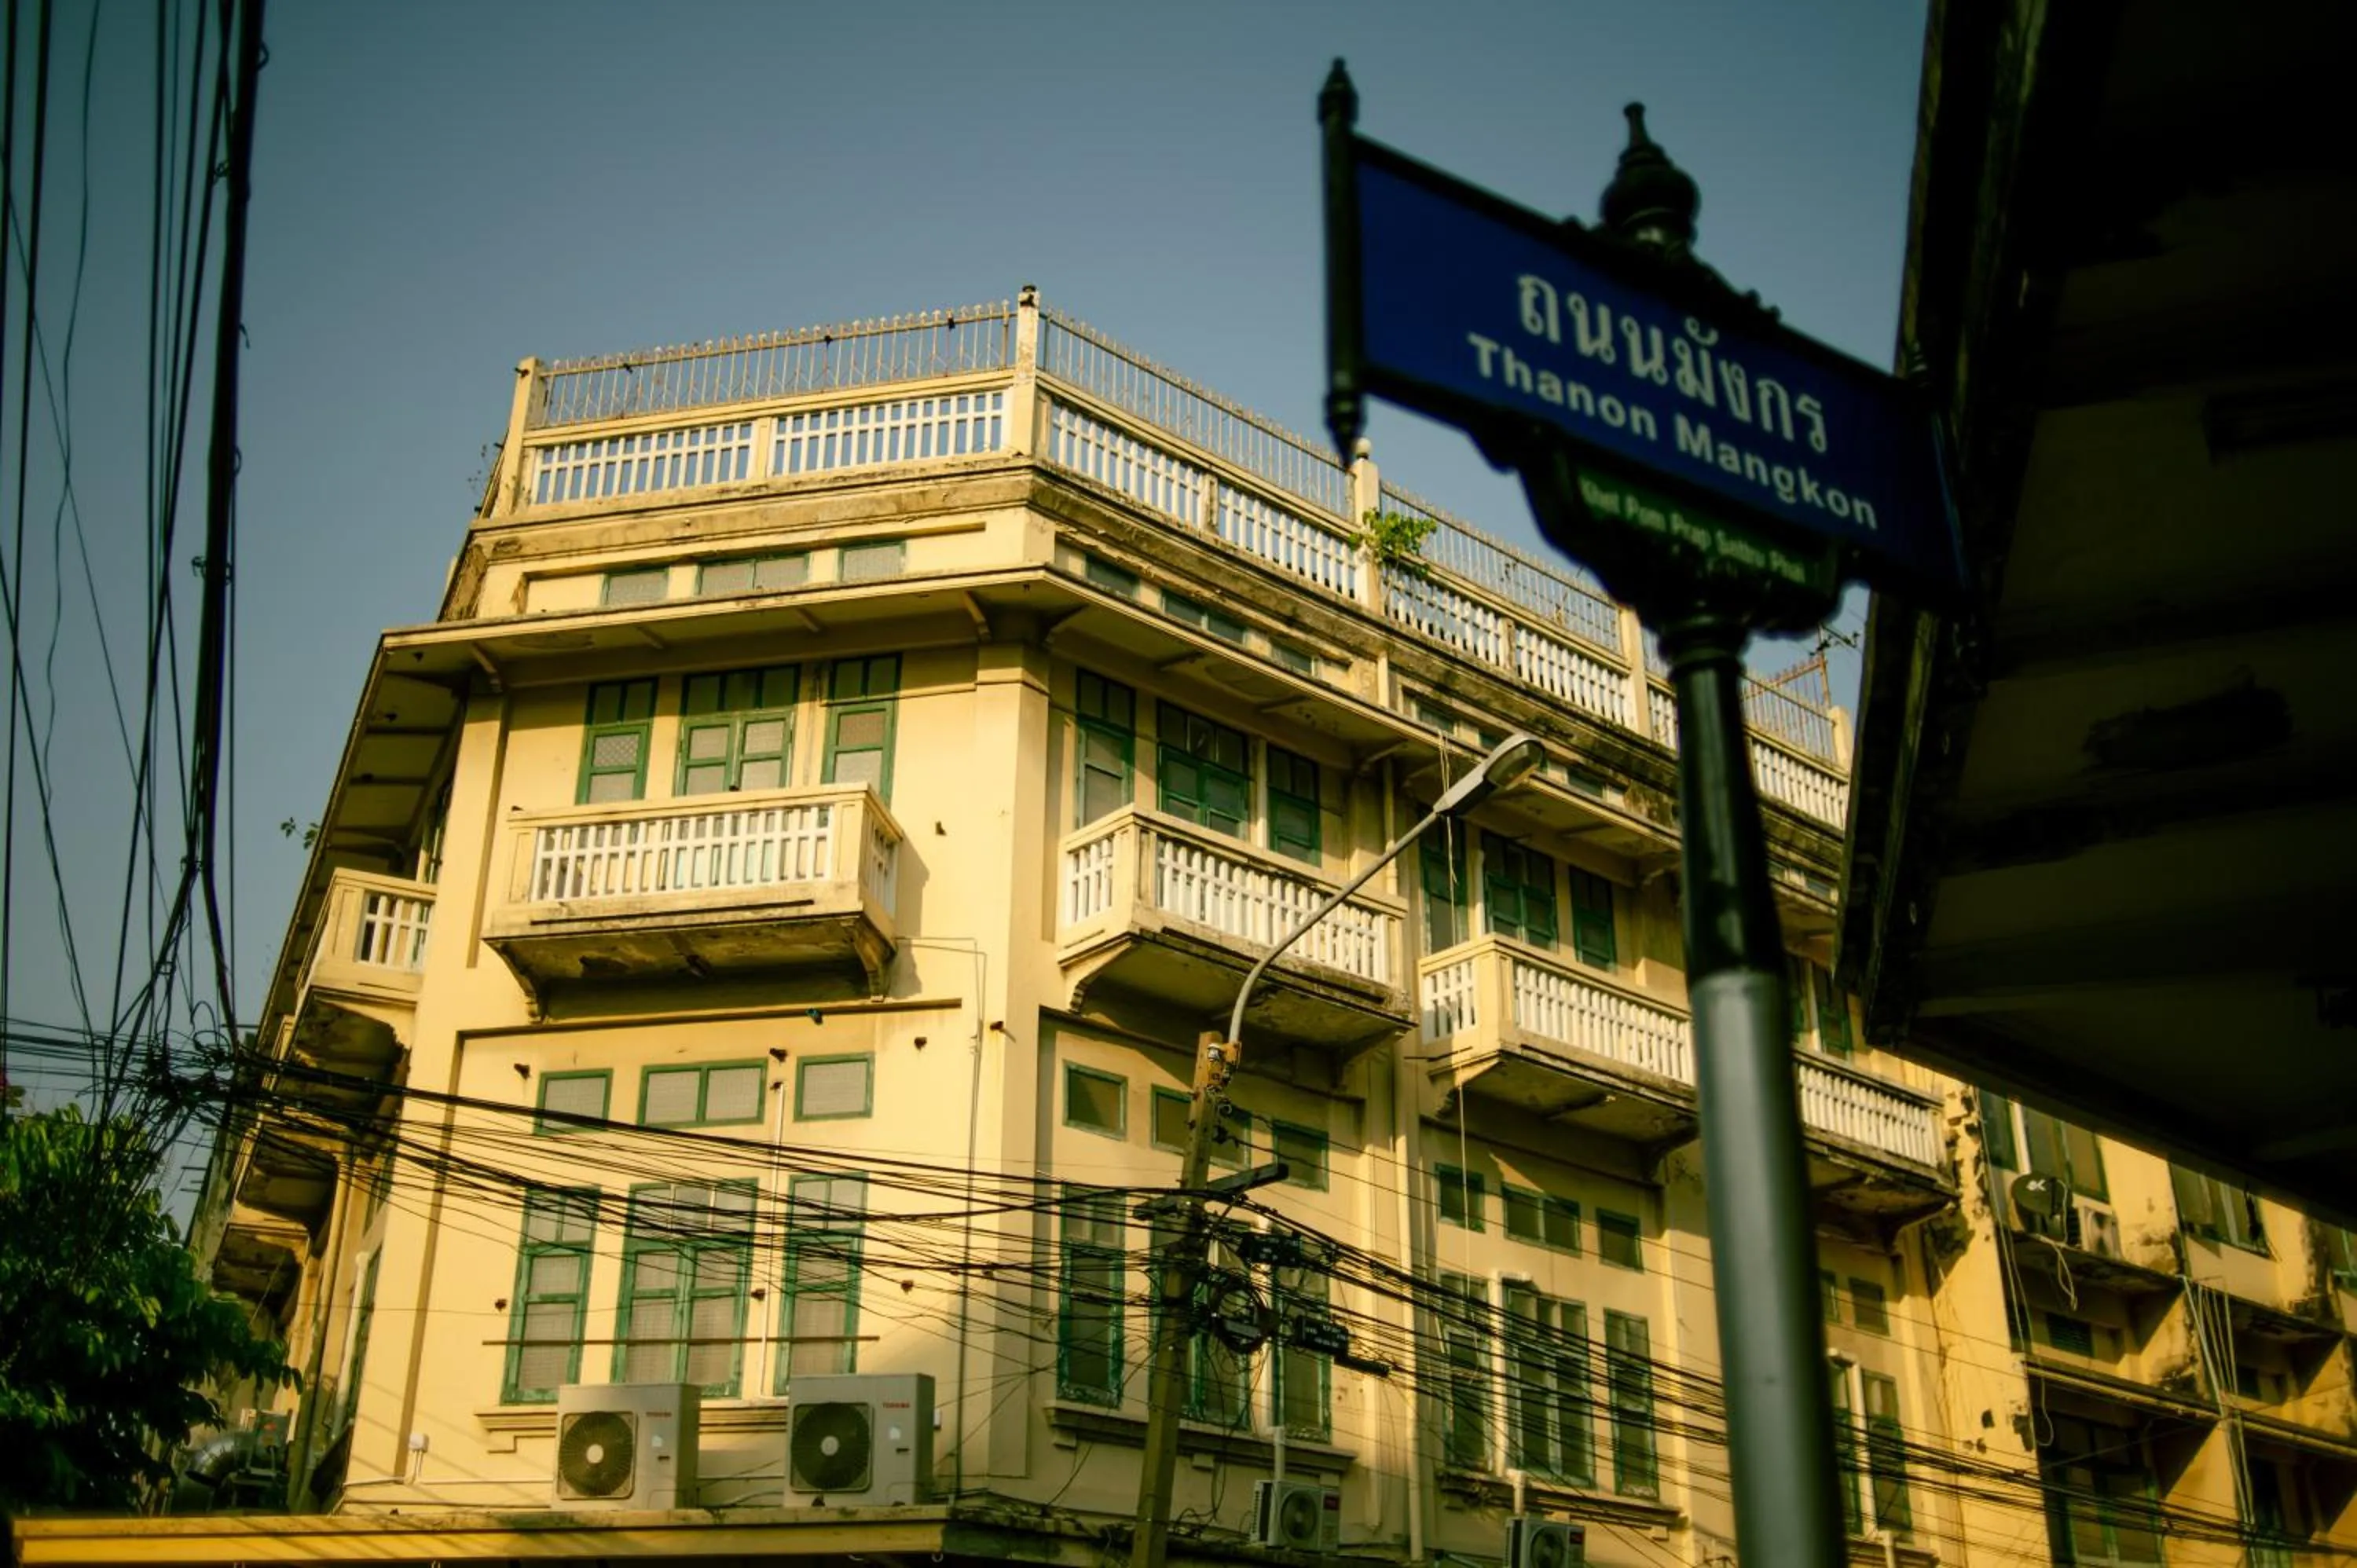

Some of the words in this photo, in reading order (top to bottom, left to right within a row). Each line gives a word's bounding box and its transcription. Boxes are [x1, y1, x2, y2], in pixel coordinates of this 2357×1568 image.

[1468, 332, 1657, 441] Thanon
[1674, 412, 1877, 529] Mangkon
[1517, 274, 1827, 452] ถนนมังกร
